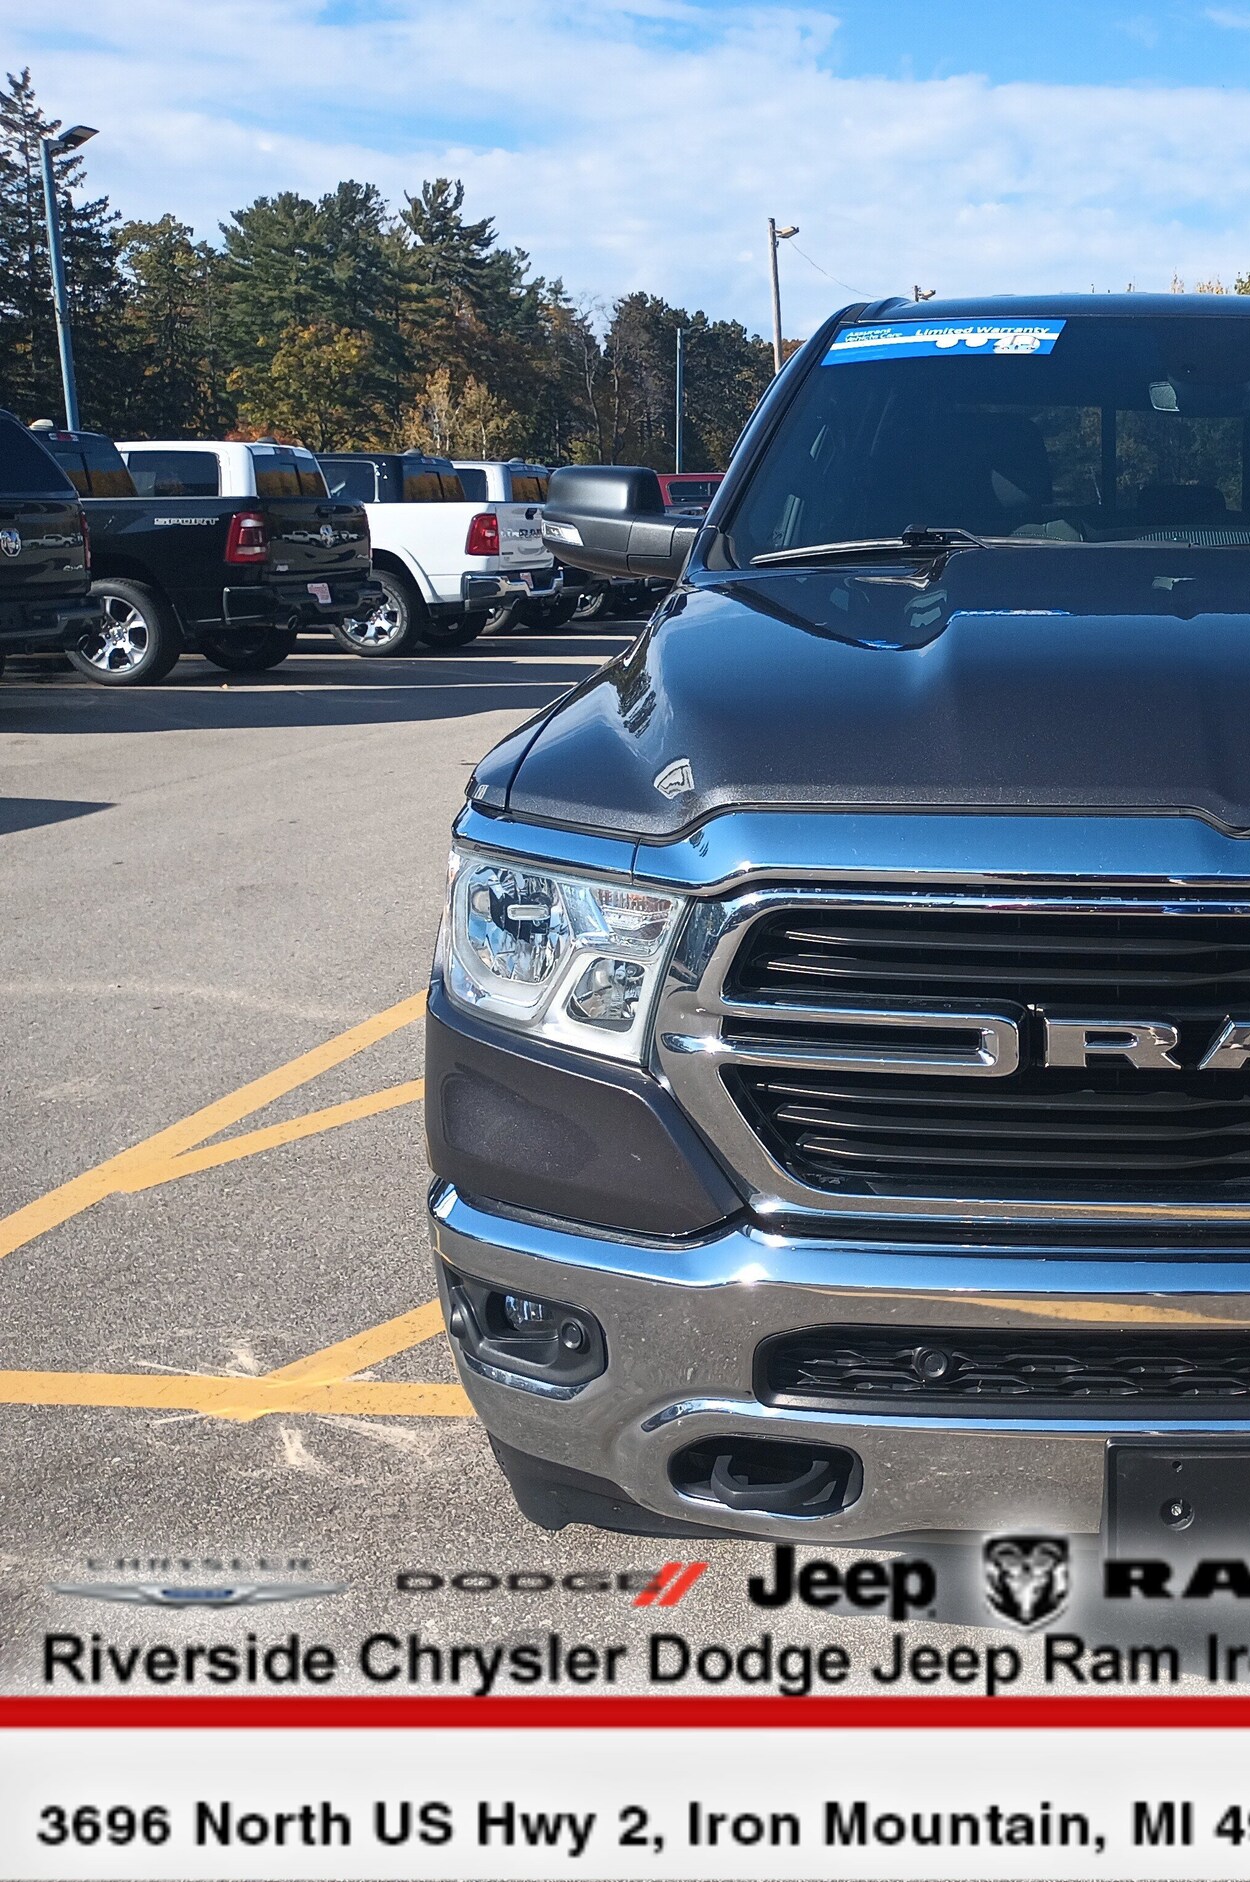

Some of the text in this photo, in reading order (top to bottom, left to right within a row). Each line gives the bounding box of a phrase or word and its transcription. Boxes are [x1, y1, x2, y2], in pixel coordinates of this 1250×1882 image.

[914, 325, 1050, 337] Limited Warranty
[154, 517, 220, 526] SPORT
